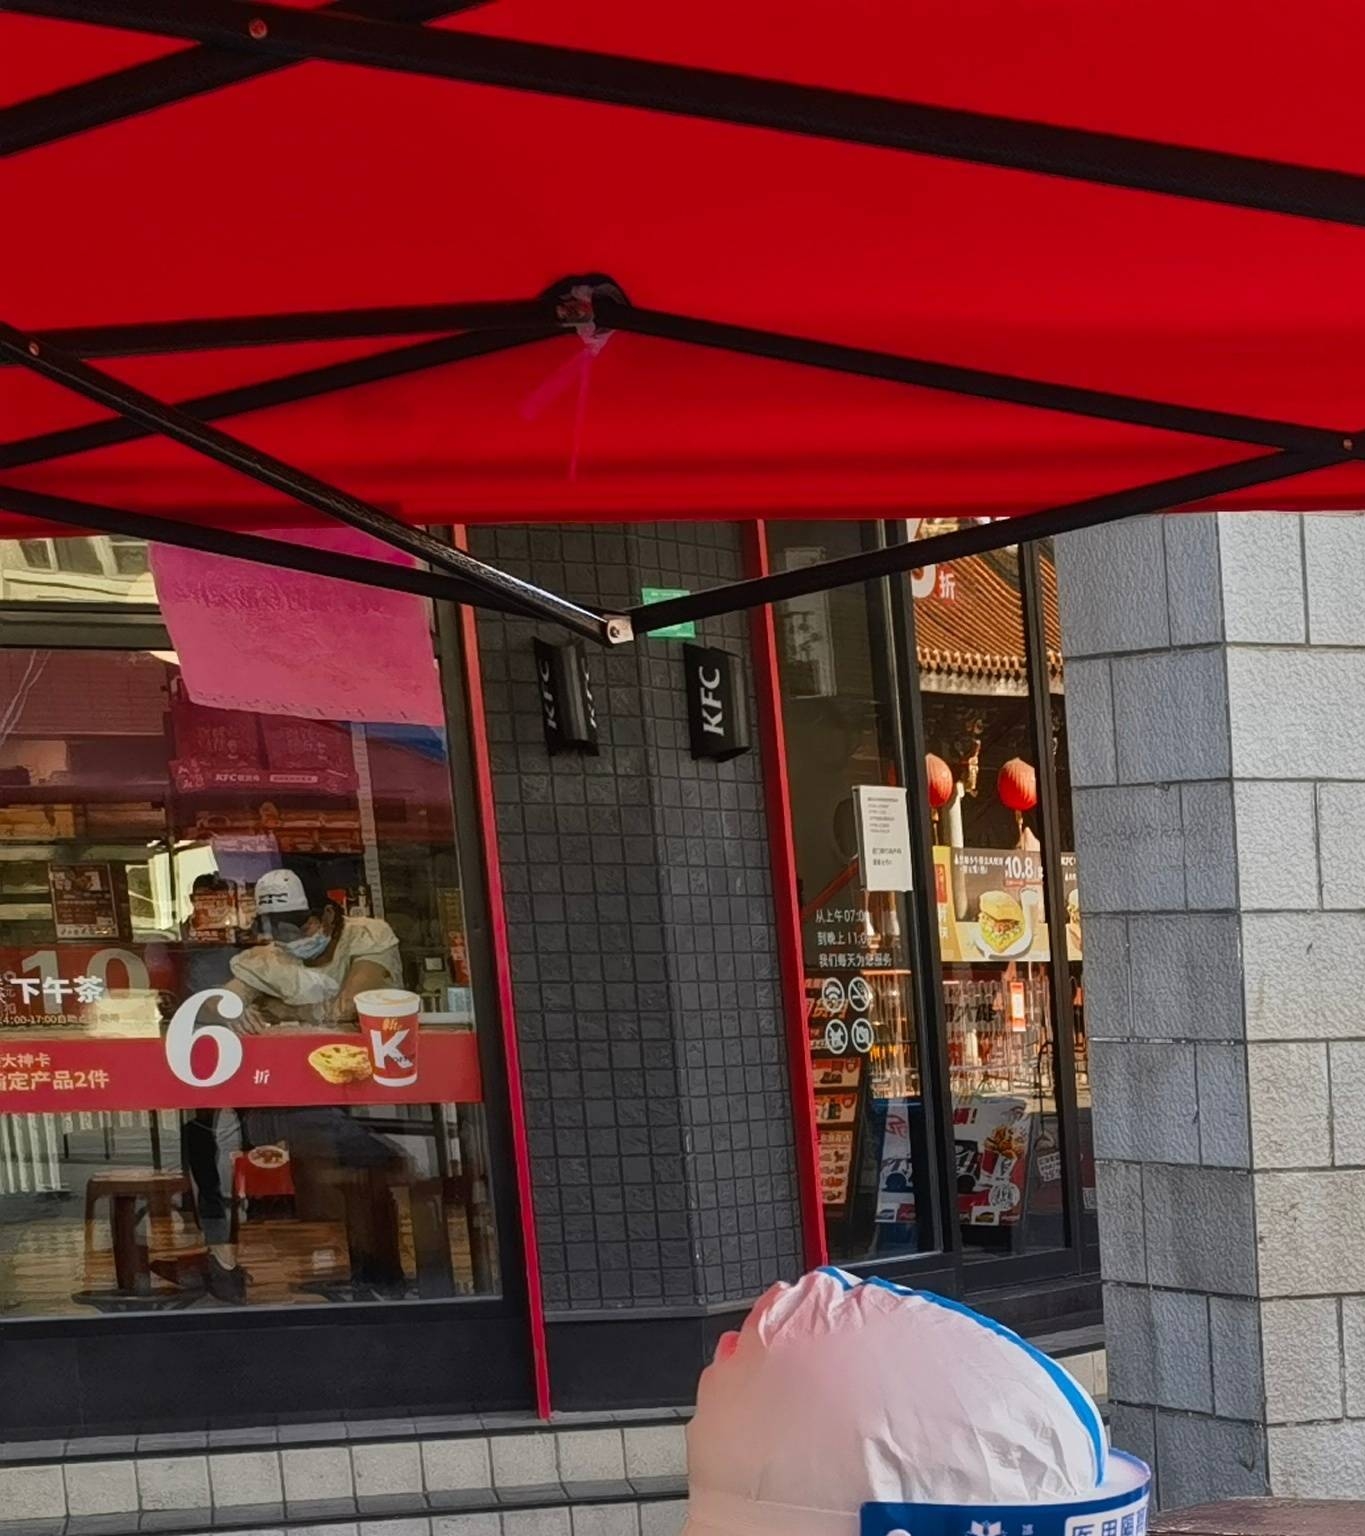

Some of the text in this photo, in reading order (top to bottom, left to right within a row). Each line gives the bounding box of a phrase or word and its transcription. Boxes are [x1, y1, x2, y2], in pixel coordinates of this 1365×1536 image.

[698, 666, 725, 737] KFC
[0, 975, 104, 1005] 下午茶
[0, 1052, 51, 1068] 大神卡
[165, 988, 244, 1087] 6
